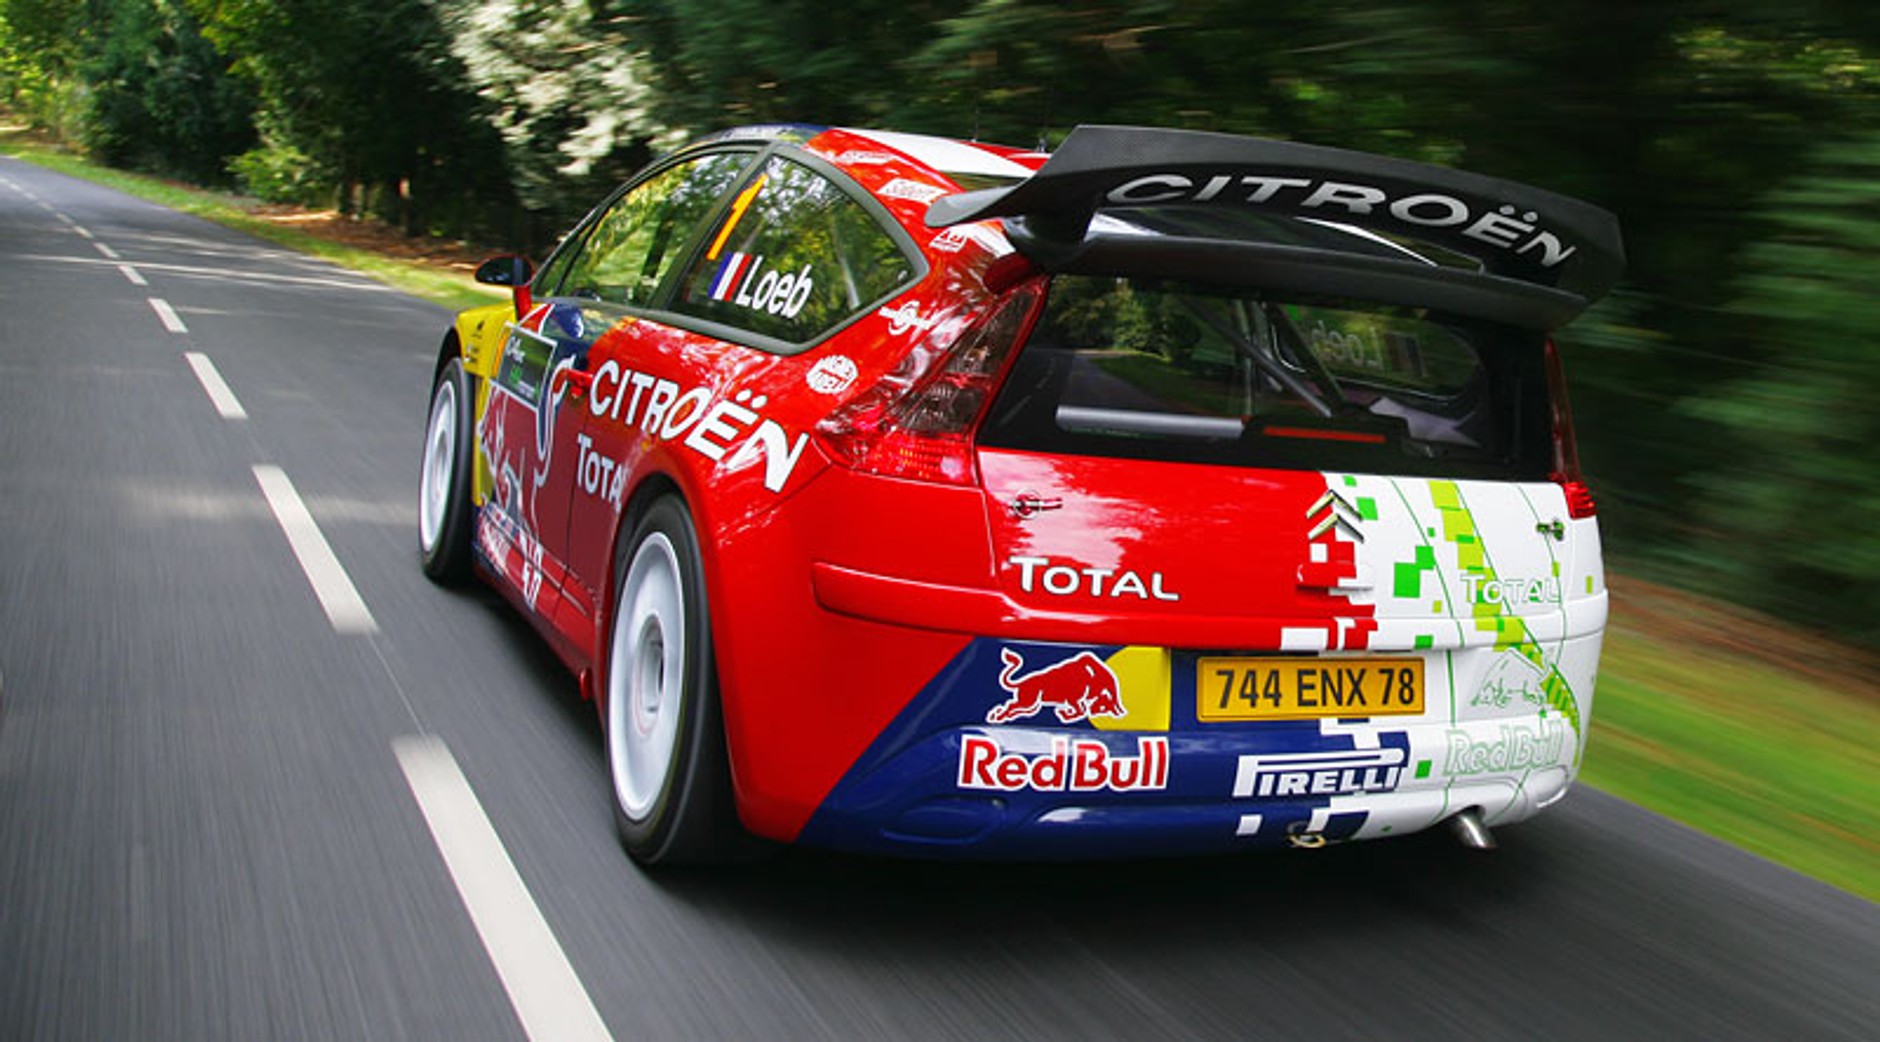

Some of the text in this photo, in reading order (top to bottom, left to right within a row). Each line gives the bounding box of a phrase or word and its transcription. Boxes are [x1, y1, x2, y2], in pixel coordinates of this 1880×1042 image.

[707, 174, 769, 260] 1
[1107, 175, 1576, 267] CITROËN
[736, 257, 812, 318] Loeb
[589, 360, 809, 493] CITROËN
[1216, 667, 1414, 709] 744 ENX 78
[1232, 747, 1408, 797] PIRELLI
